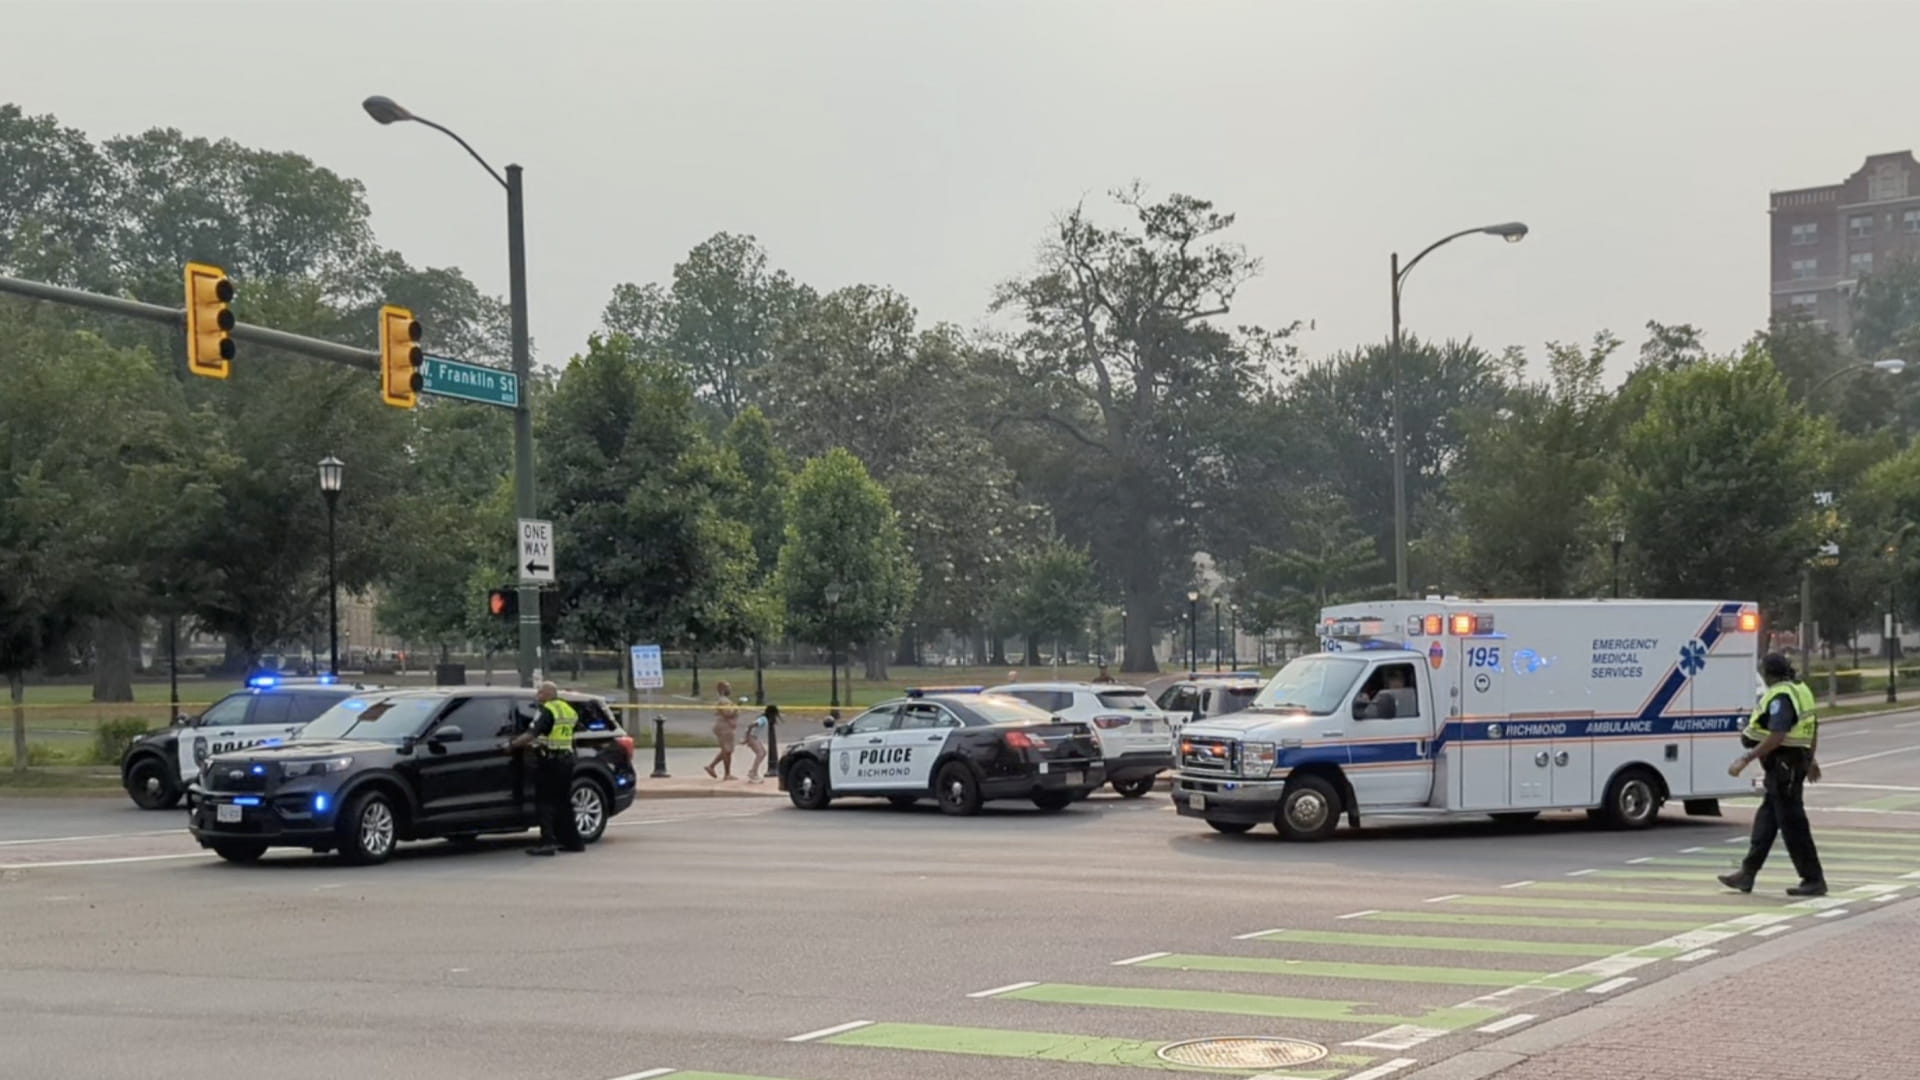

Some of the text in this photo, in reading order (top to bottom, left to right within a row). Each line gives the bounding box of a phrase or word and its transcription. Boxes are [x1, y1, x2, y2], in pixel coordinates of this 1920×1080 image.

[439, 364, 494, 388] Franklin
[500, 375, 514, 393] St
[524, 525, 547, 540] ONE
[525, 542, 548, 556] WAY
[1592, 639, 1658, 651] EMERGENCY
[1467, 648, 1500, 667] 195
[1592, 652, 1639, 665] MEDICAL
[1591, 666, 1643, 679] SERVICES
[1506, 718, 1730, 737] RICHMOND AMBULANCE AUTHORITY
[212, 738, 282, 754] POL
[859, 748, 912, 765] POLICE
[858, 767, 911, 777] RICHMOND
